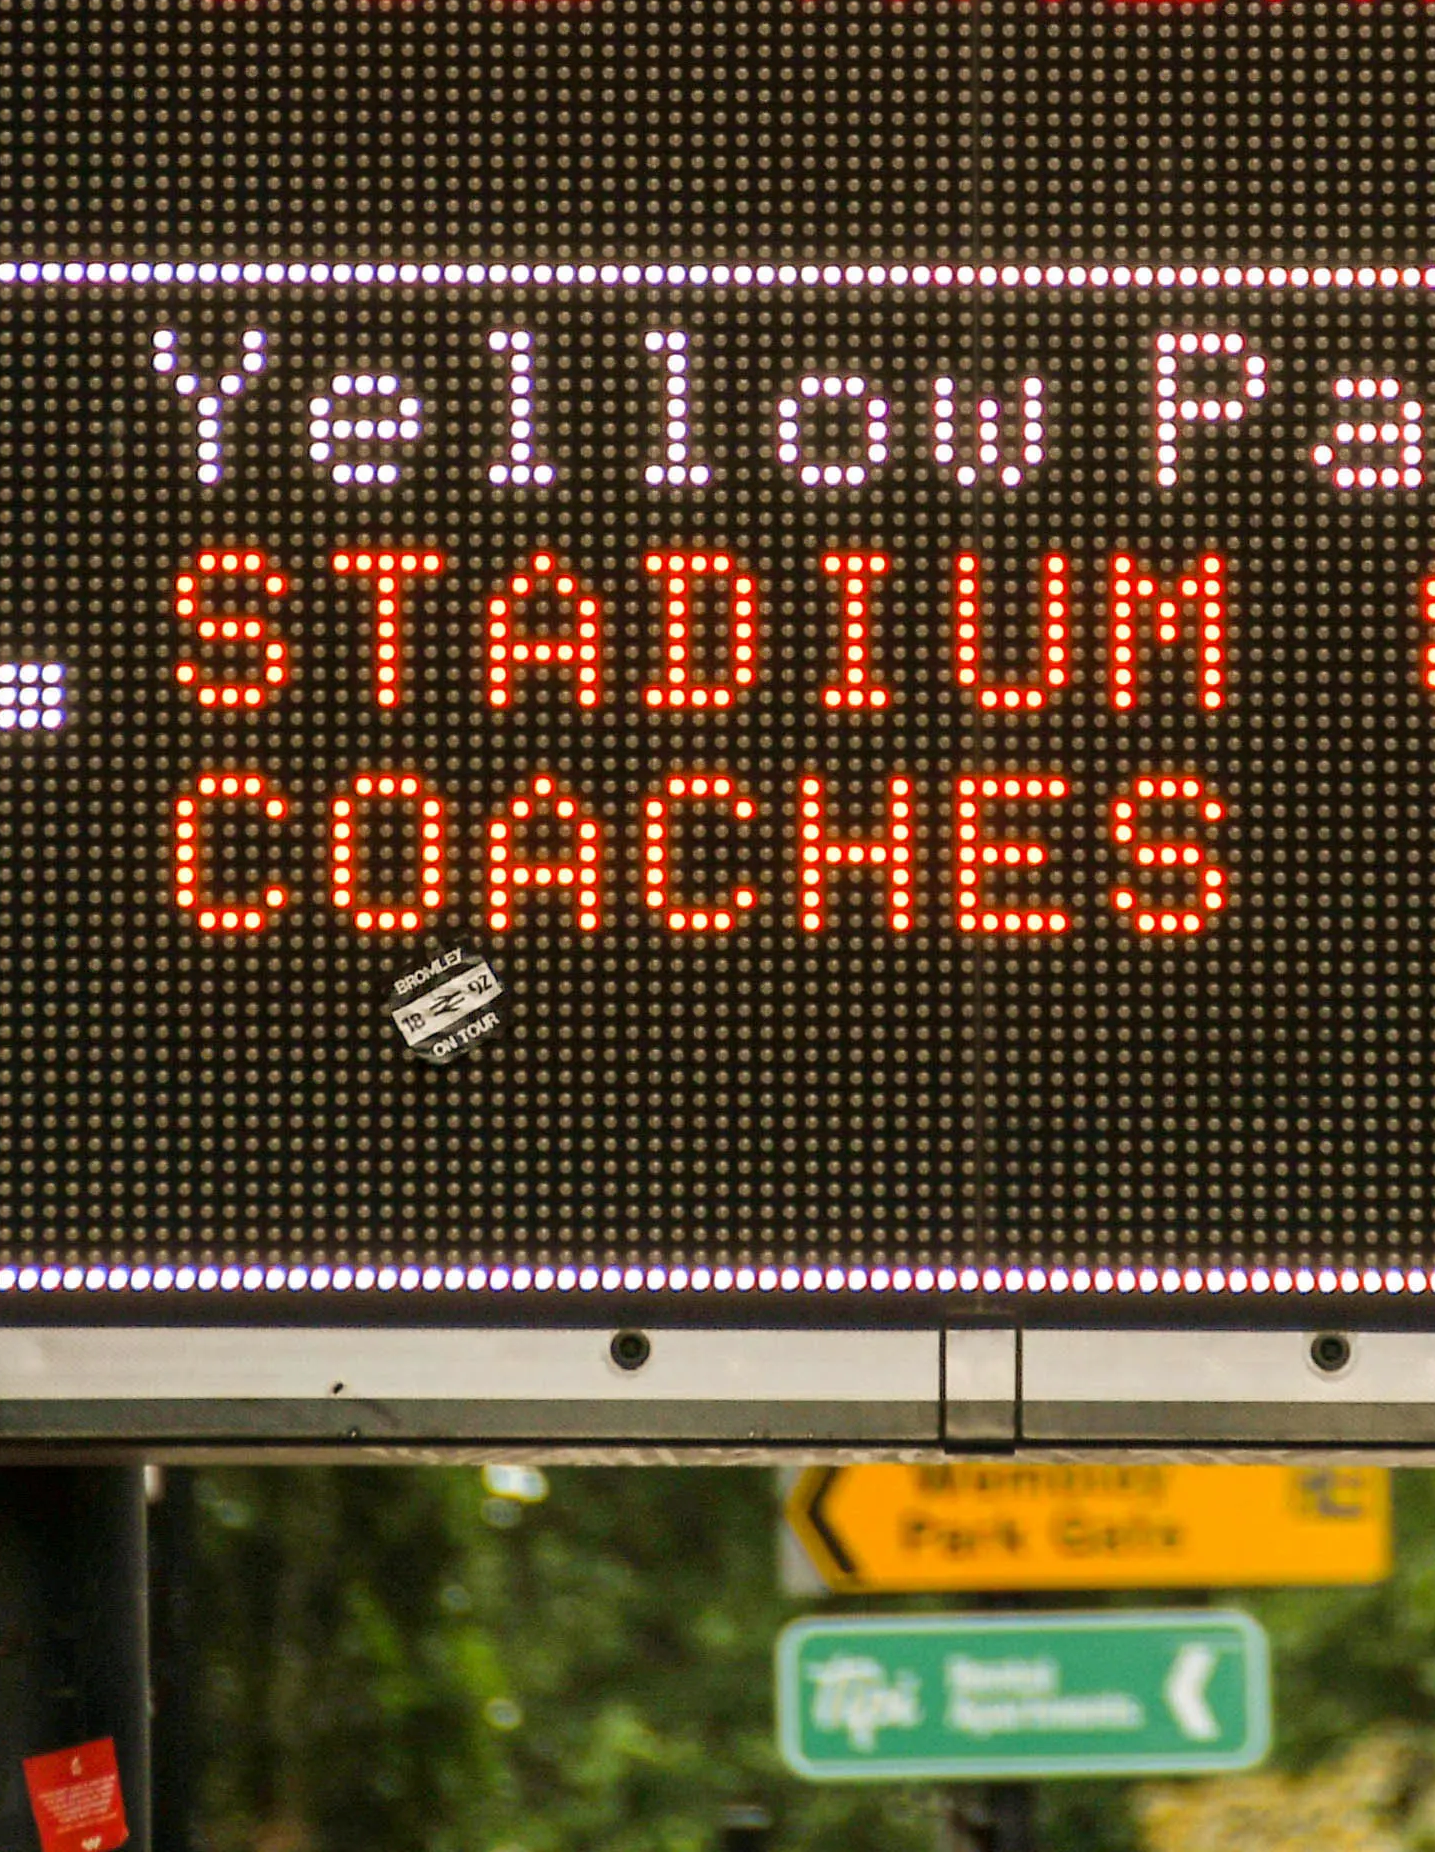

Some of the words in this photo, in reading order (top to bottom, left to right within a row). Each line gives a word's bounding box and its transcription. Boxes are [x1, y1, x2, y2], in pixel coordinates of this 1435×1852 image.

[150, 328, 1046, 489] Yellow
[173, 547, 1228, 714] STADIUM
[172, 770, 1229, 937] COACHES
[393, 948, 463, 996] BROMLEY
[400, 1011, 427, 1033] 18
[467, 973, 493, 996] 92
[432, 1035, 459, 1057] ON
[456, 1012, 501, 1044] TOUR
